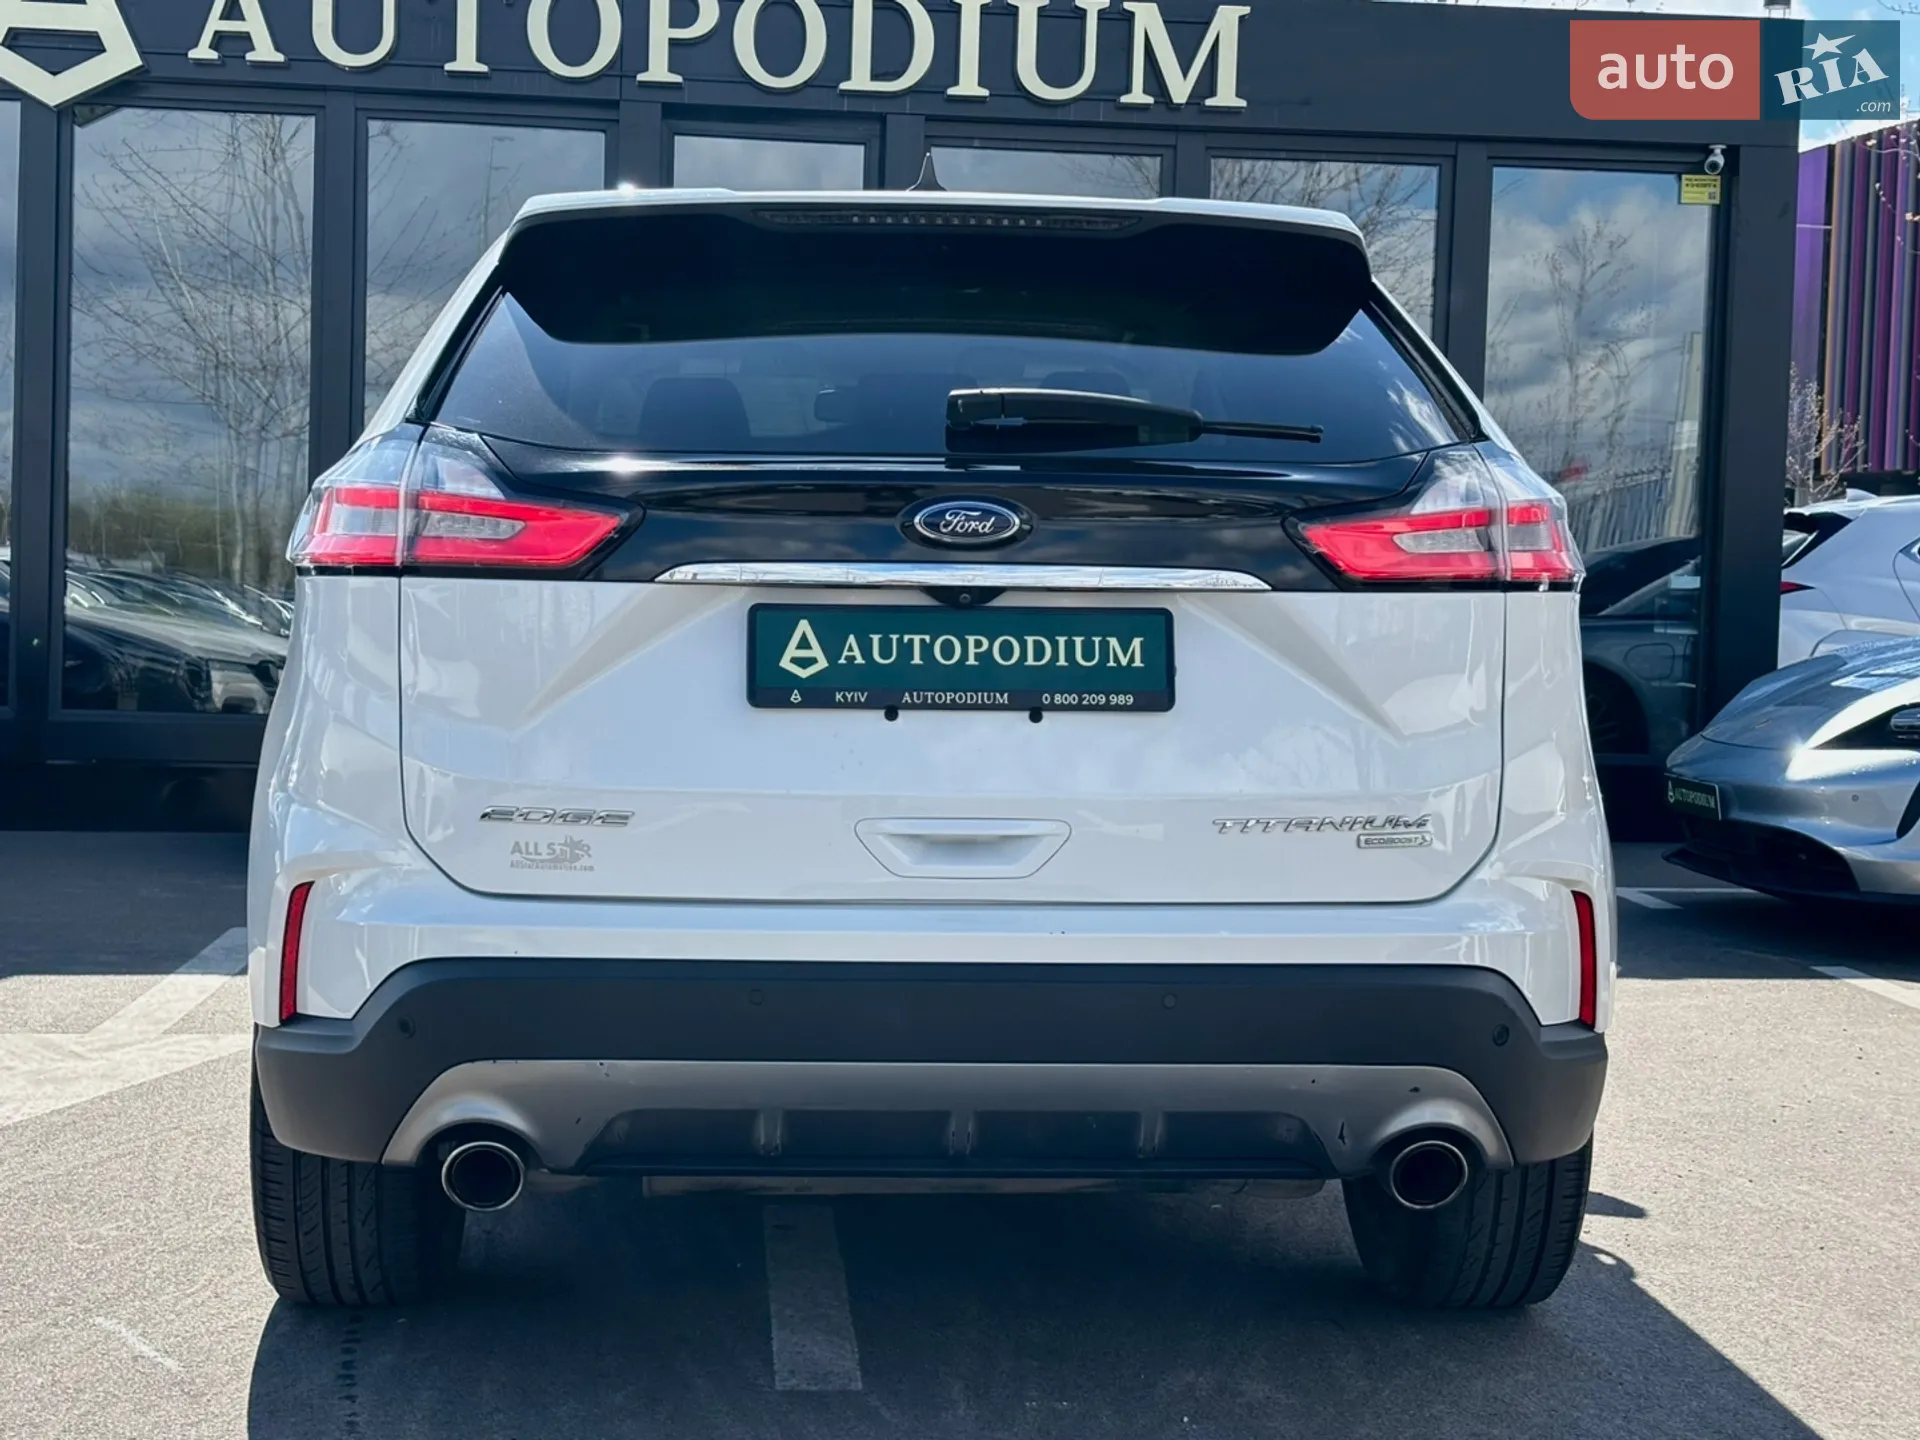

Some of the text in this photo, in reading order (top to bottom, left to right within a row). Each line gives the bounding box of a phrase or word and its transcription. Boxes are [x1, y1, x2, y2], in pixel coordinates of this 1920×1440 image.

[187, 0, 1250, 108] AUTOPODIUM
[939, 508, 996, 535] Ford
[837, 634, 1145, 668] AUTOPODIUM
[835, 691, 868, 703] KYIV
[902, 691, 1009, 704] AUTOPODIUM
[1042, 693, 1134, 706] 0 800 209 989
[479, 805, 635, 828] EDGE
[1212, 814, 1432, 834] TITANIUM
[510, 840, 543, 857] ALL
[1364, 836, 1419, 846] ECOBOOST
